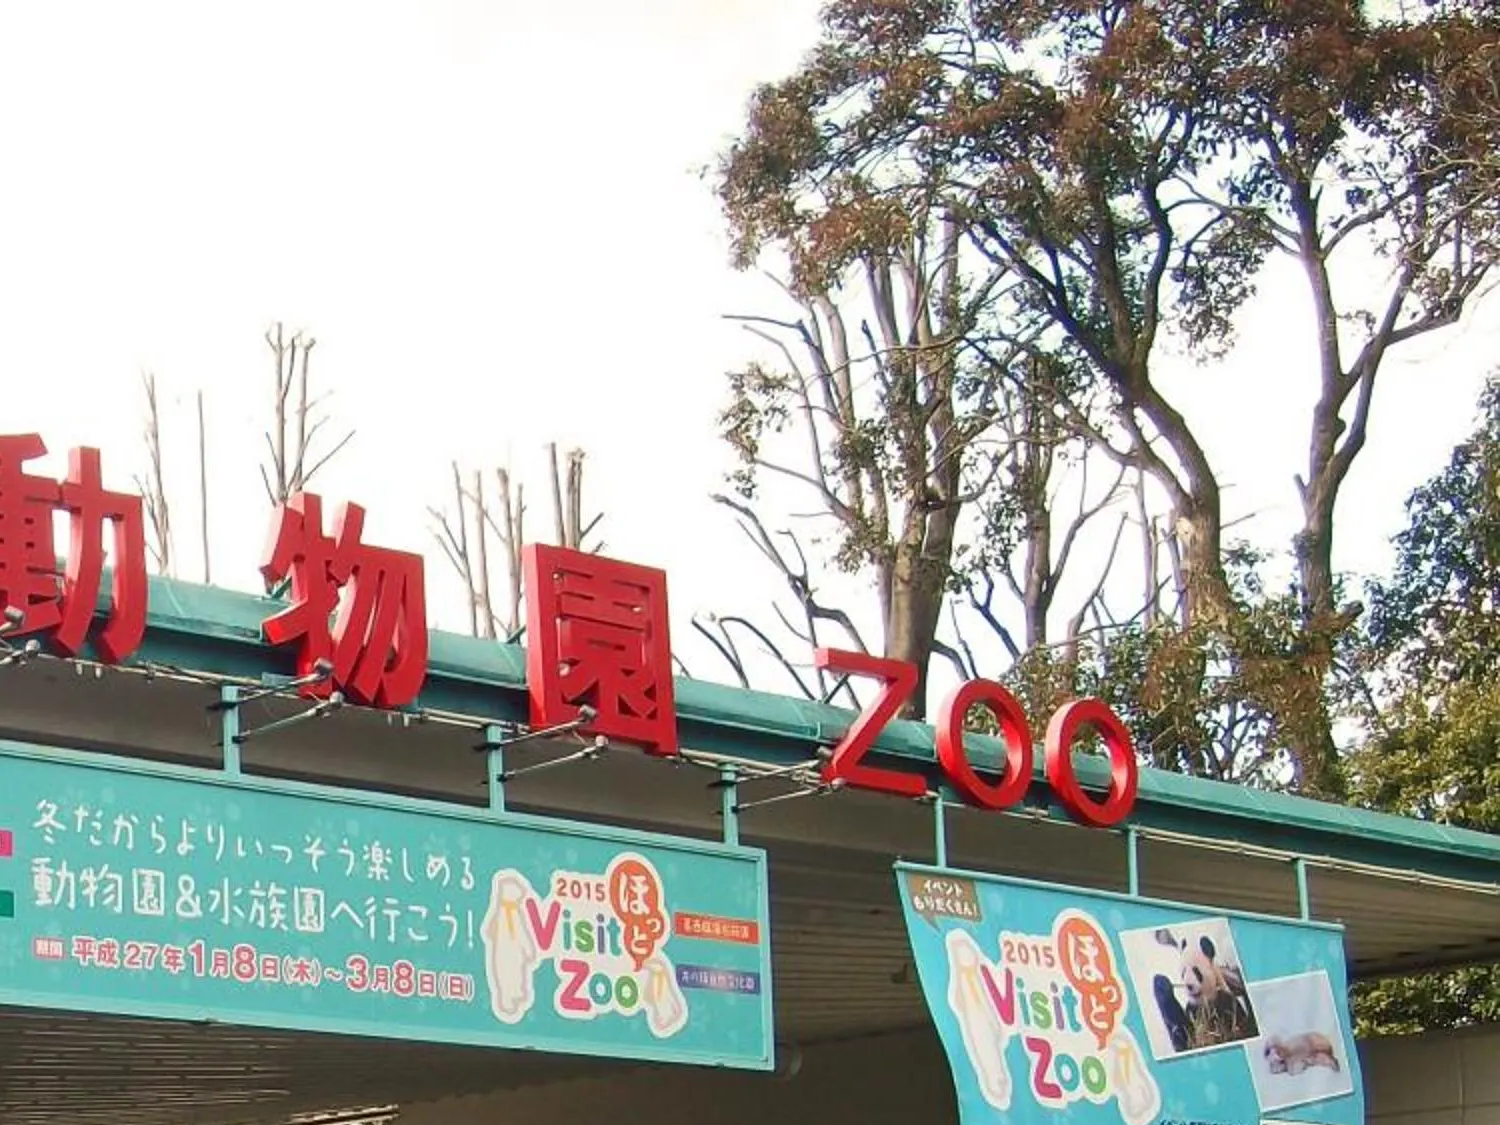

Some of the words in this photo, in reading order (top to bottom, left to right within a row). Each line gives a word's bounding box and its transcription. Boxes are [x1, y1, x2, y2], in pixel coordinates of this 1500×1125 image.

[30, 798, 476, 890] 冬だからよりいっそう楽しめる
[556, 877, 606, 902] 2015
[619, 872, 661, 955] ほっと
[525, 898, 621, 955] Visit
[1003, 938, 1056, 969] 2015
[558, 959, 639, 1013] Zoo
[980, 964, 1082, 1033] Visit
[1066, 931, 1120, 1030] ほっと
[1026, 1036, 1108, 1100] Zoo
